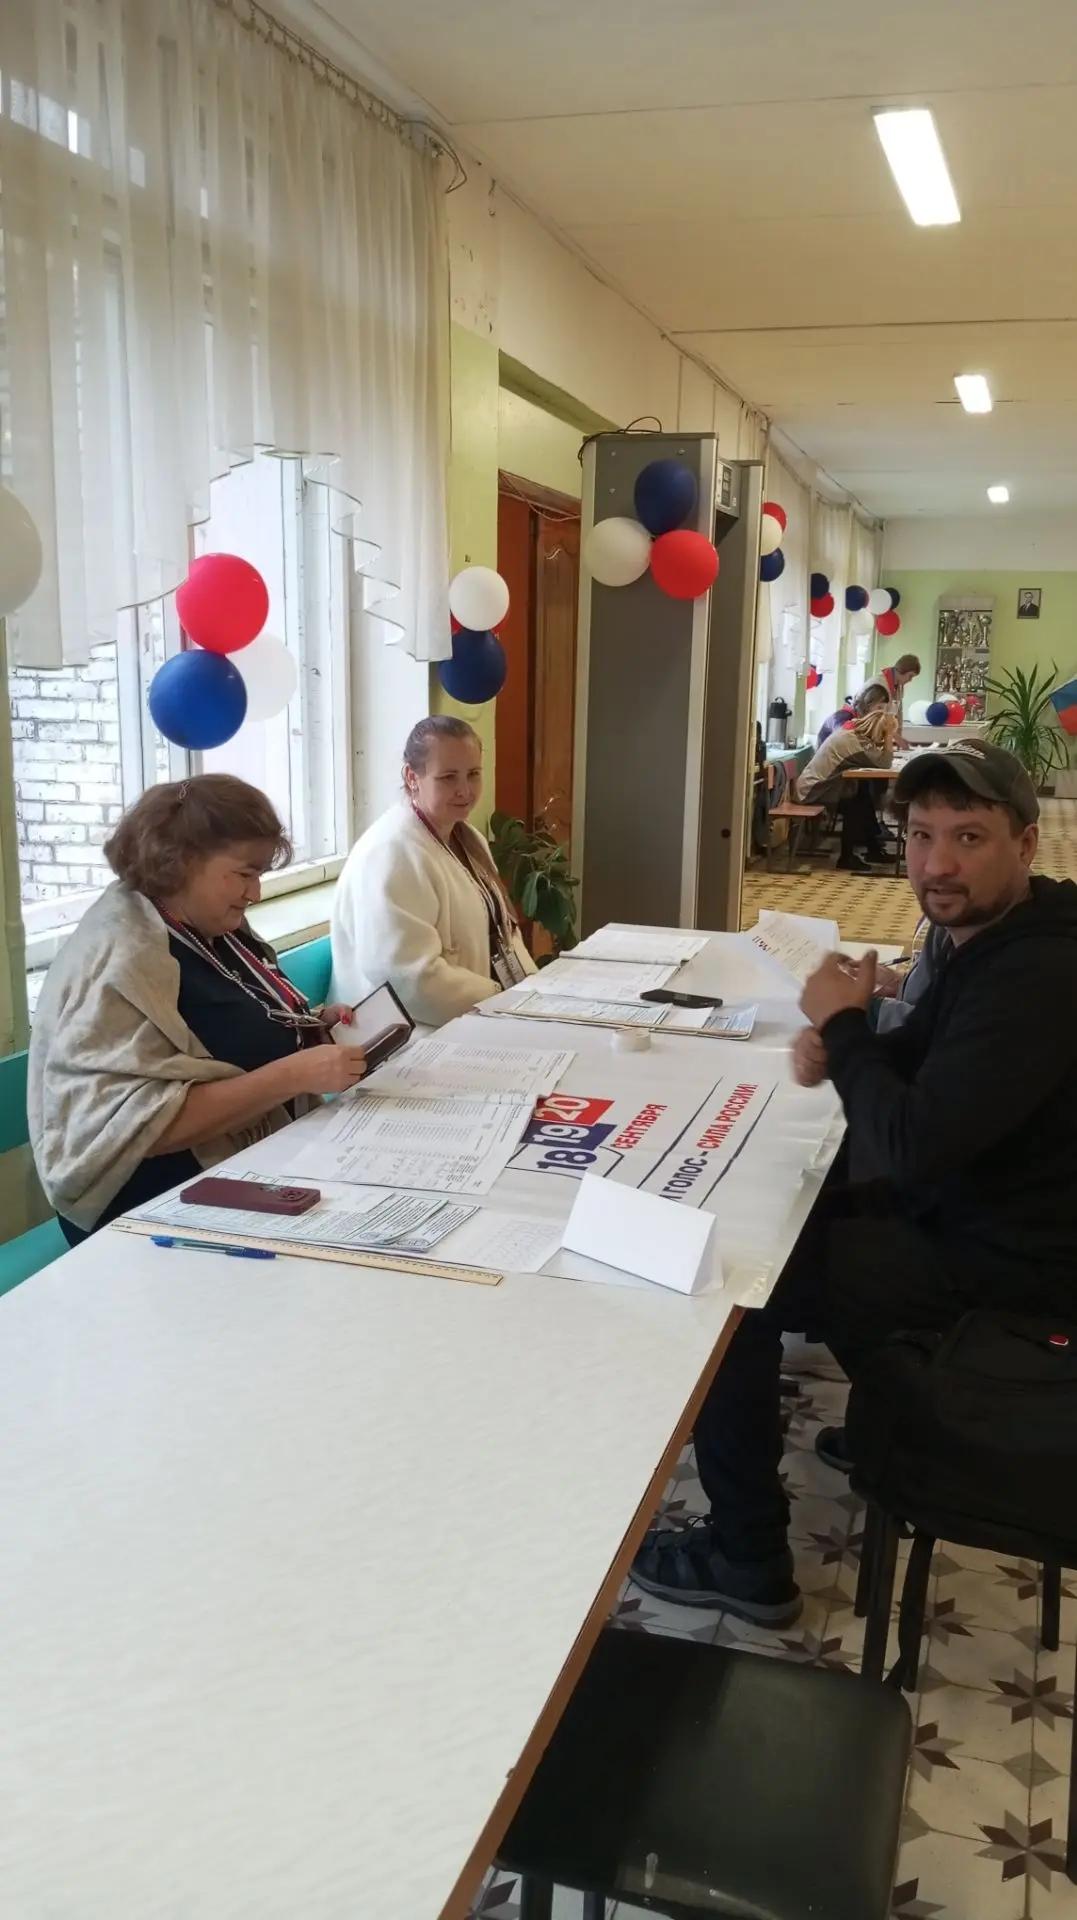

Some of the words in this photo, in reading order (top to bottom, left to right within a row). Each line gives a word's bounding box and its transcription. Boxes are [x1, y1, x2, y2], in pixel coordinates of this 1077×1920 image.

[534, 1096, 591, 1121] 20
[533, 1124, 590, 1144] 19
[610, 1103, 668, 1149] СЕНТЯБРЯ
[662, 1157, 708, 1194] ГОЛОС
[696, 1124, 734, 1149] СИЛА
[715, 1083, 758, 1123] РОССИИ!
[536, 1150, 598, 1172] 18
